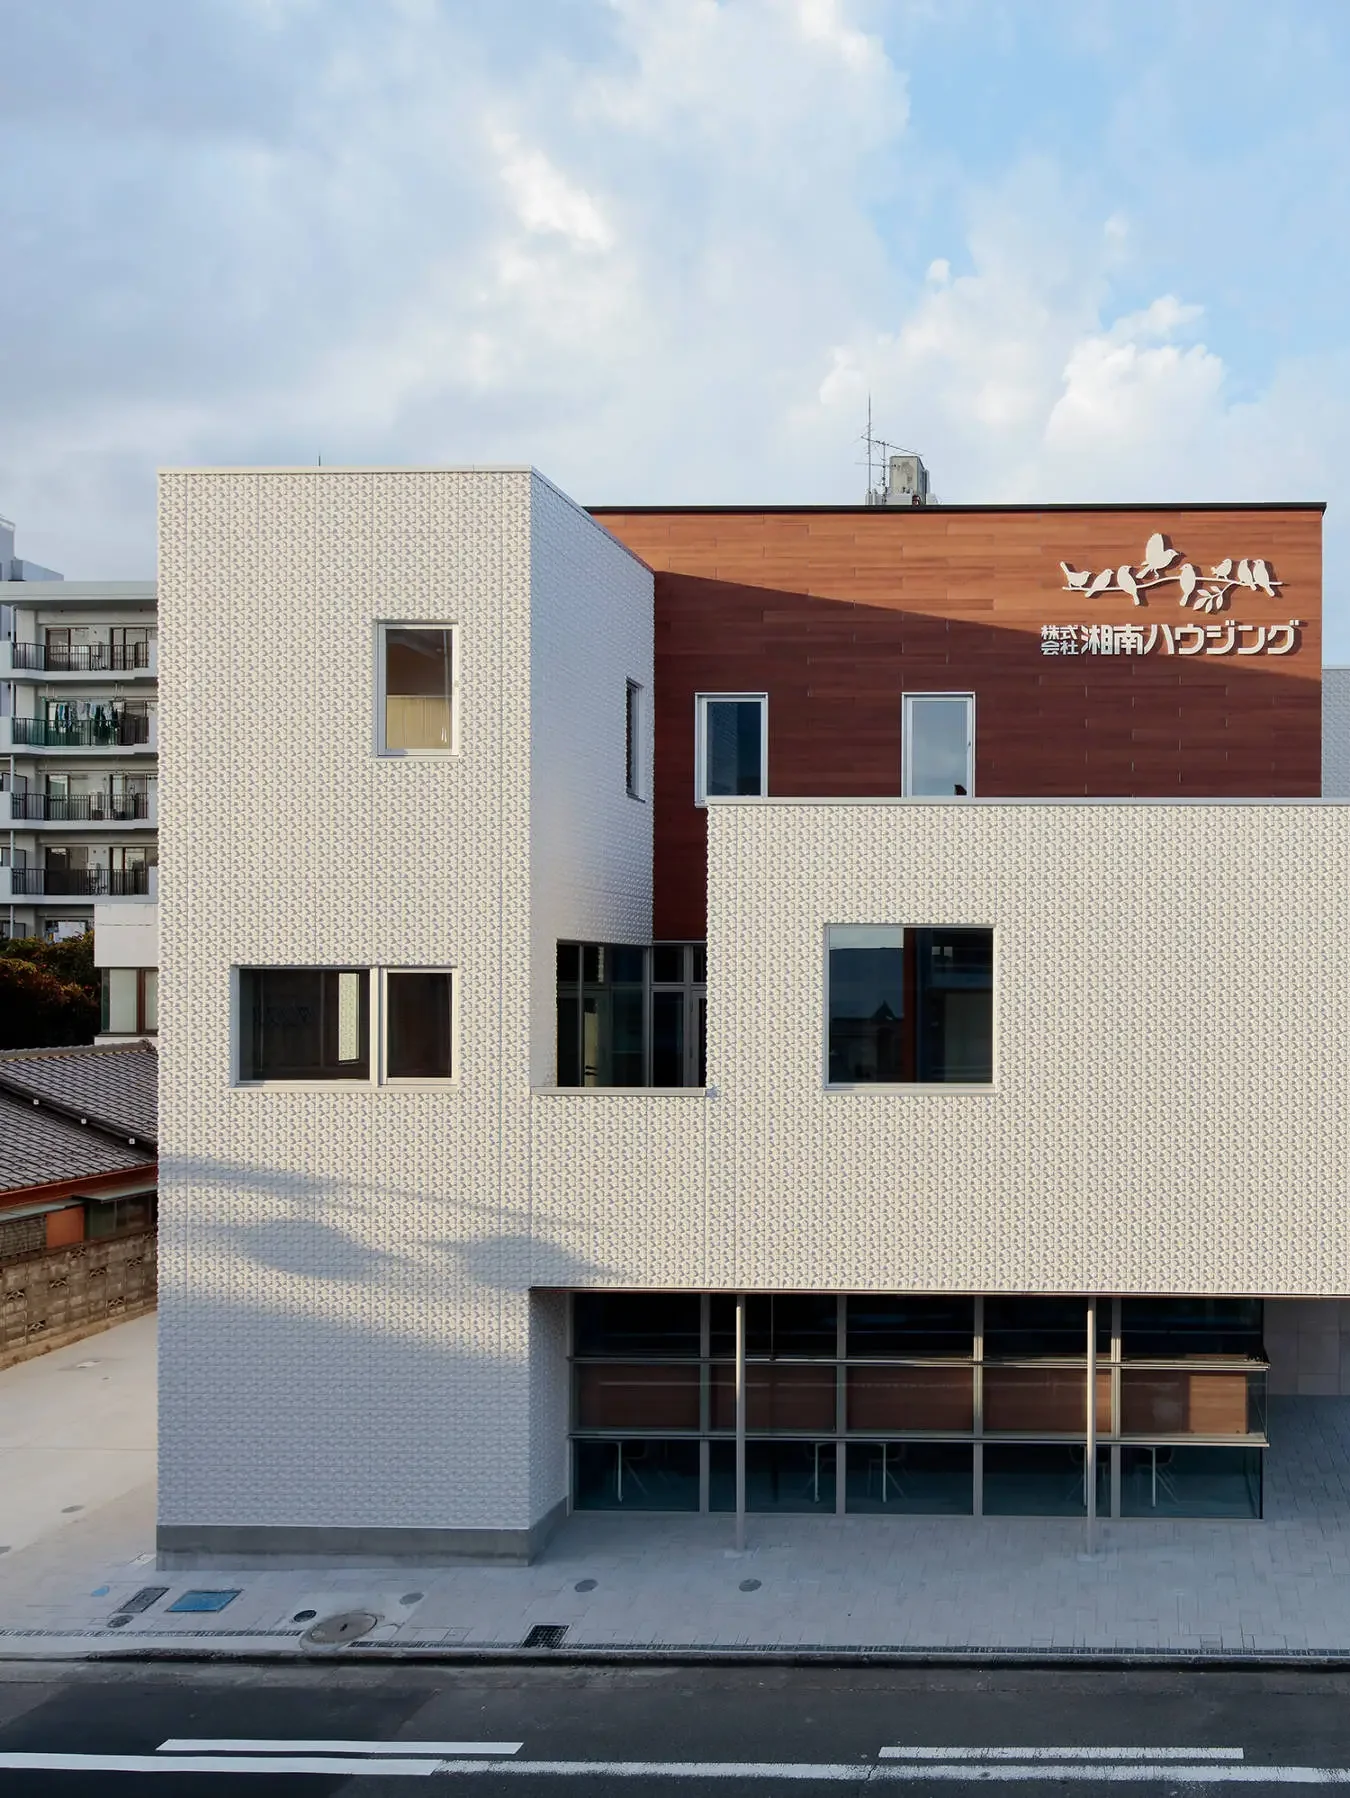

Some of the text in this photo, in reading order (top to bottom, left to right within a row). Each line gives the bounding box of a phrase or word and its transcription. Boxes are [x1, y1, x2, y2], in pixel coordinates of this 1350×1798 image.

[1041, 624, 1078, 640] 株式
[1081, 620, 1299, 655] 湘南ハウジング
[1041, 640, 1079, 655] 会社
